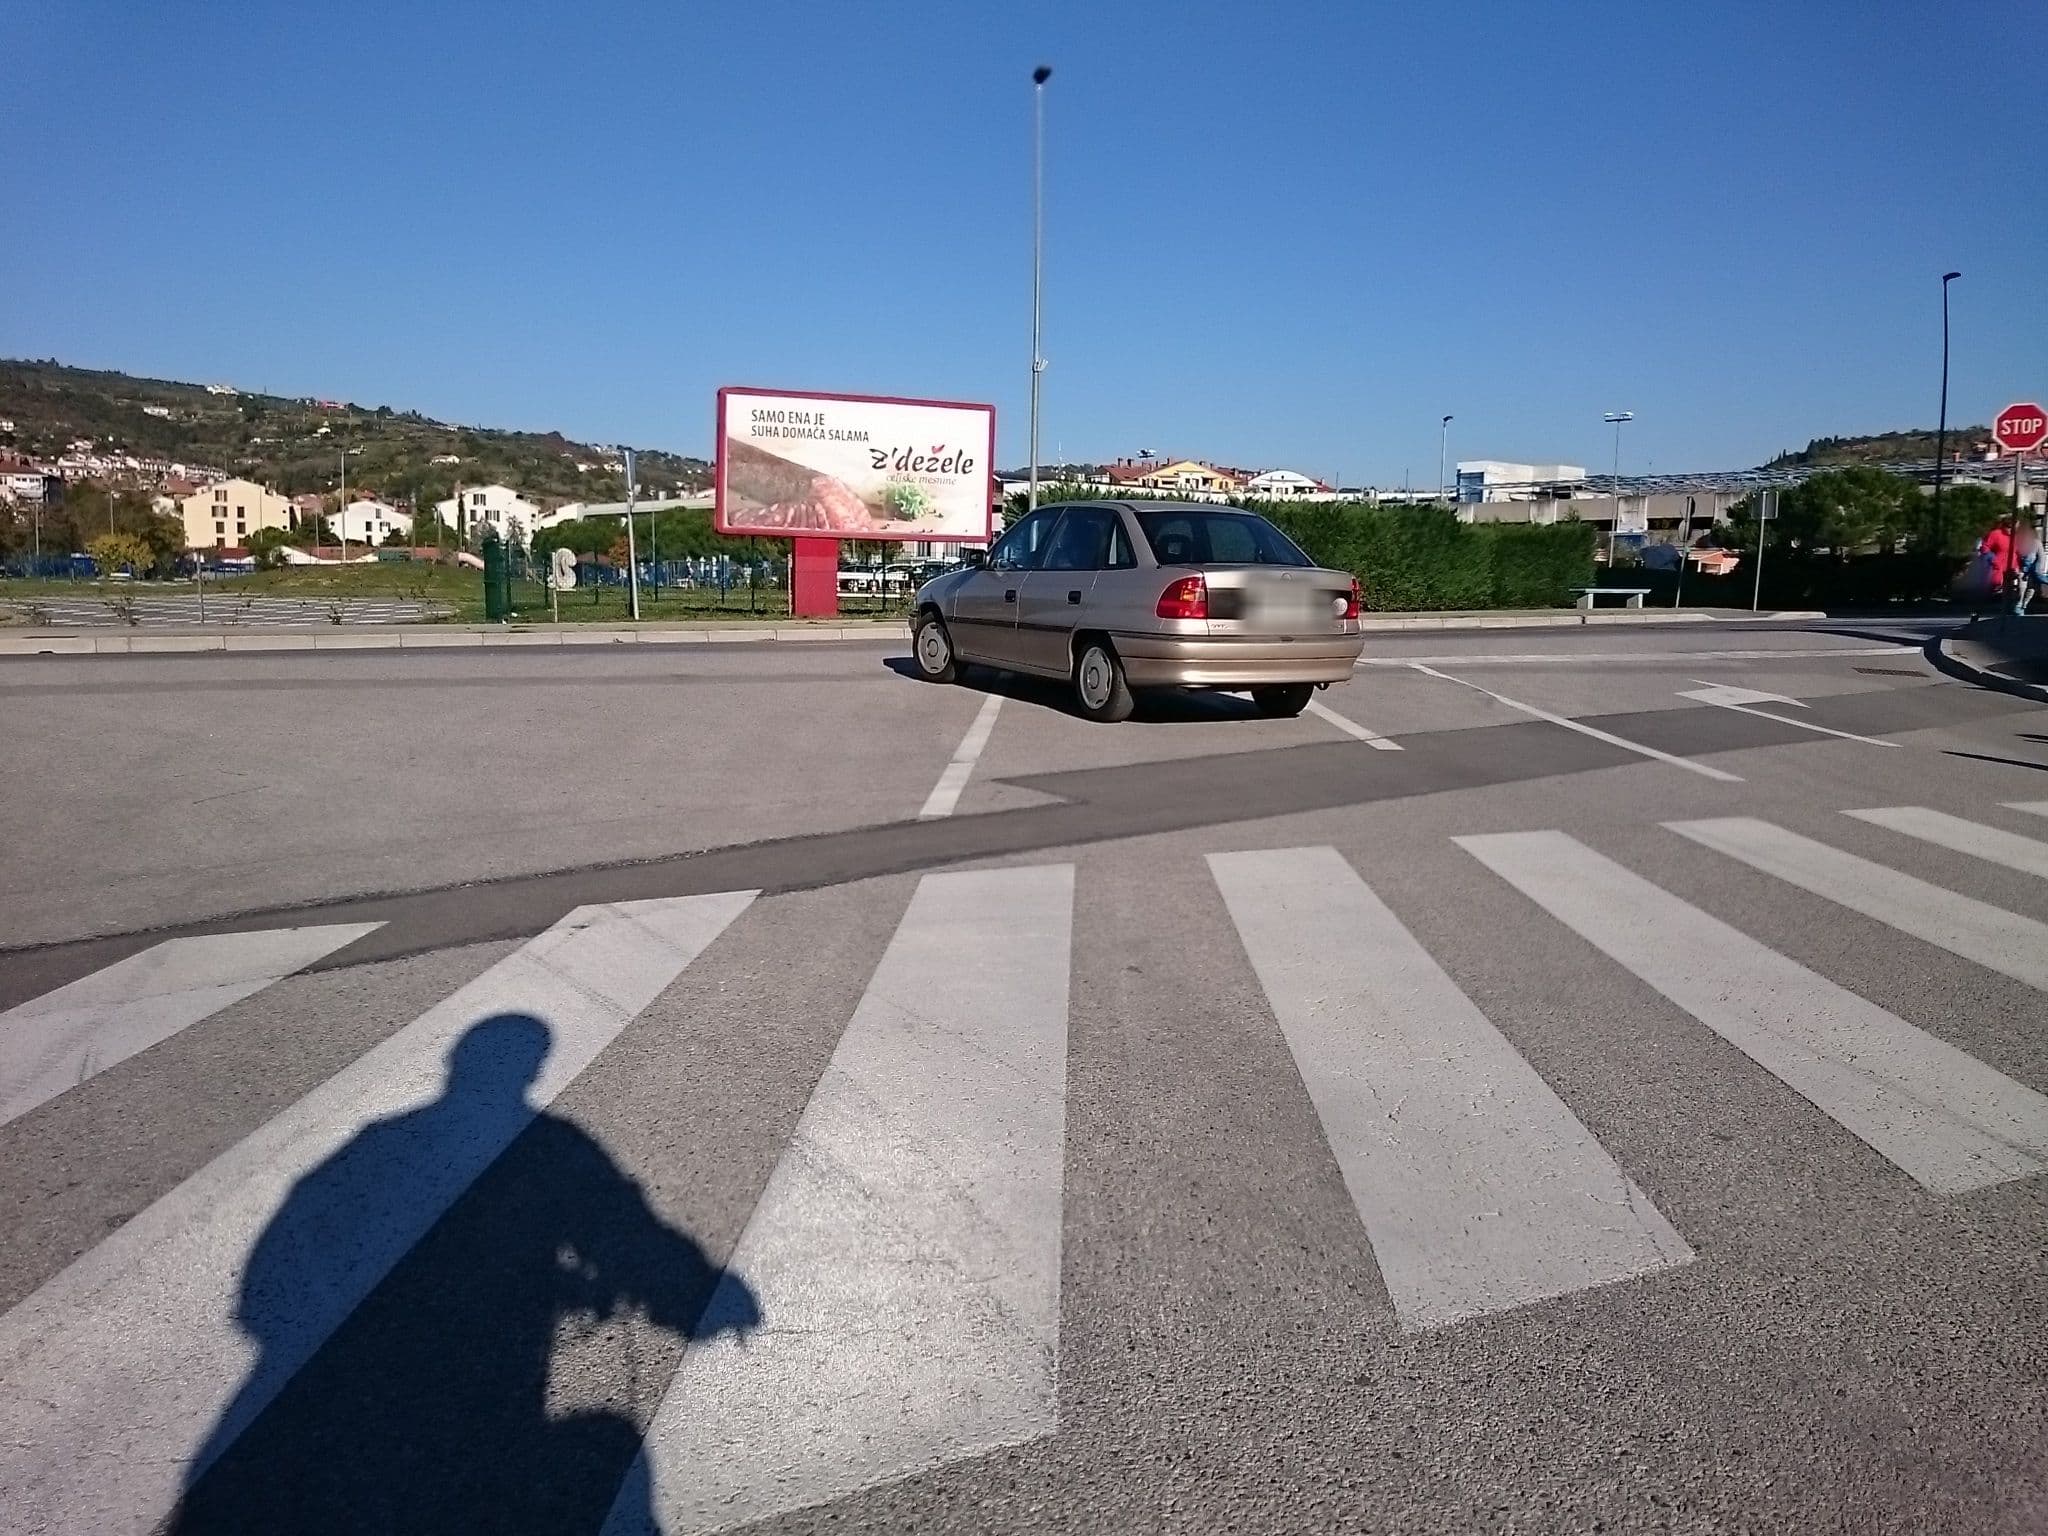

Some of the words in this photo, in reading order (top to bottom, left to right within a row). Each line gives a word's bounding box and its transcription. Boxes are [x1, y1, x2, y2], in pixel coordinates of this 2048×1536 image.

[751, 409, 785, 423] SAMO
[788, 411, 810, 425] ENA
[813, 413, 825, 426] JE
[751, 425, 780, 438] SUHA
[828, 429, 869, 442] SALAMA
[2001, 418, 2043, 435] STOP
